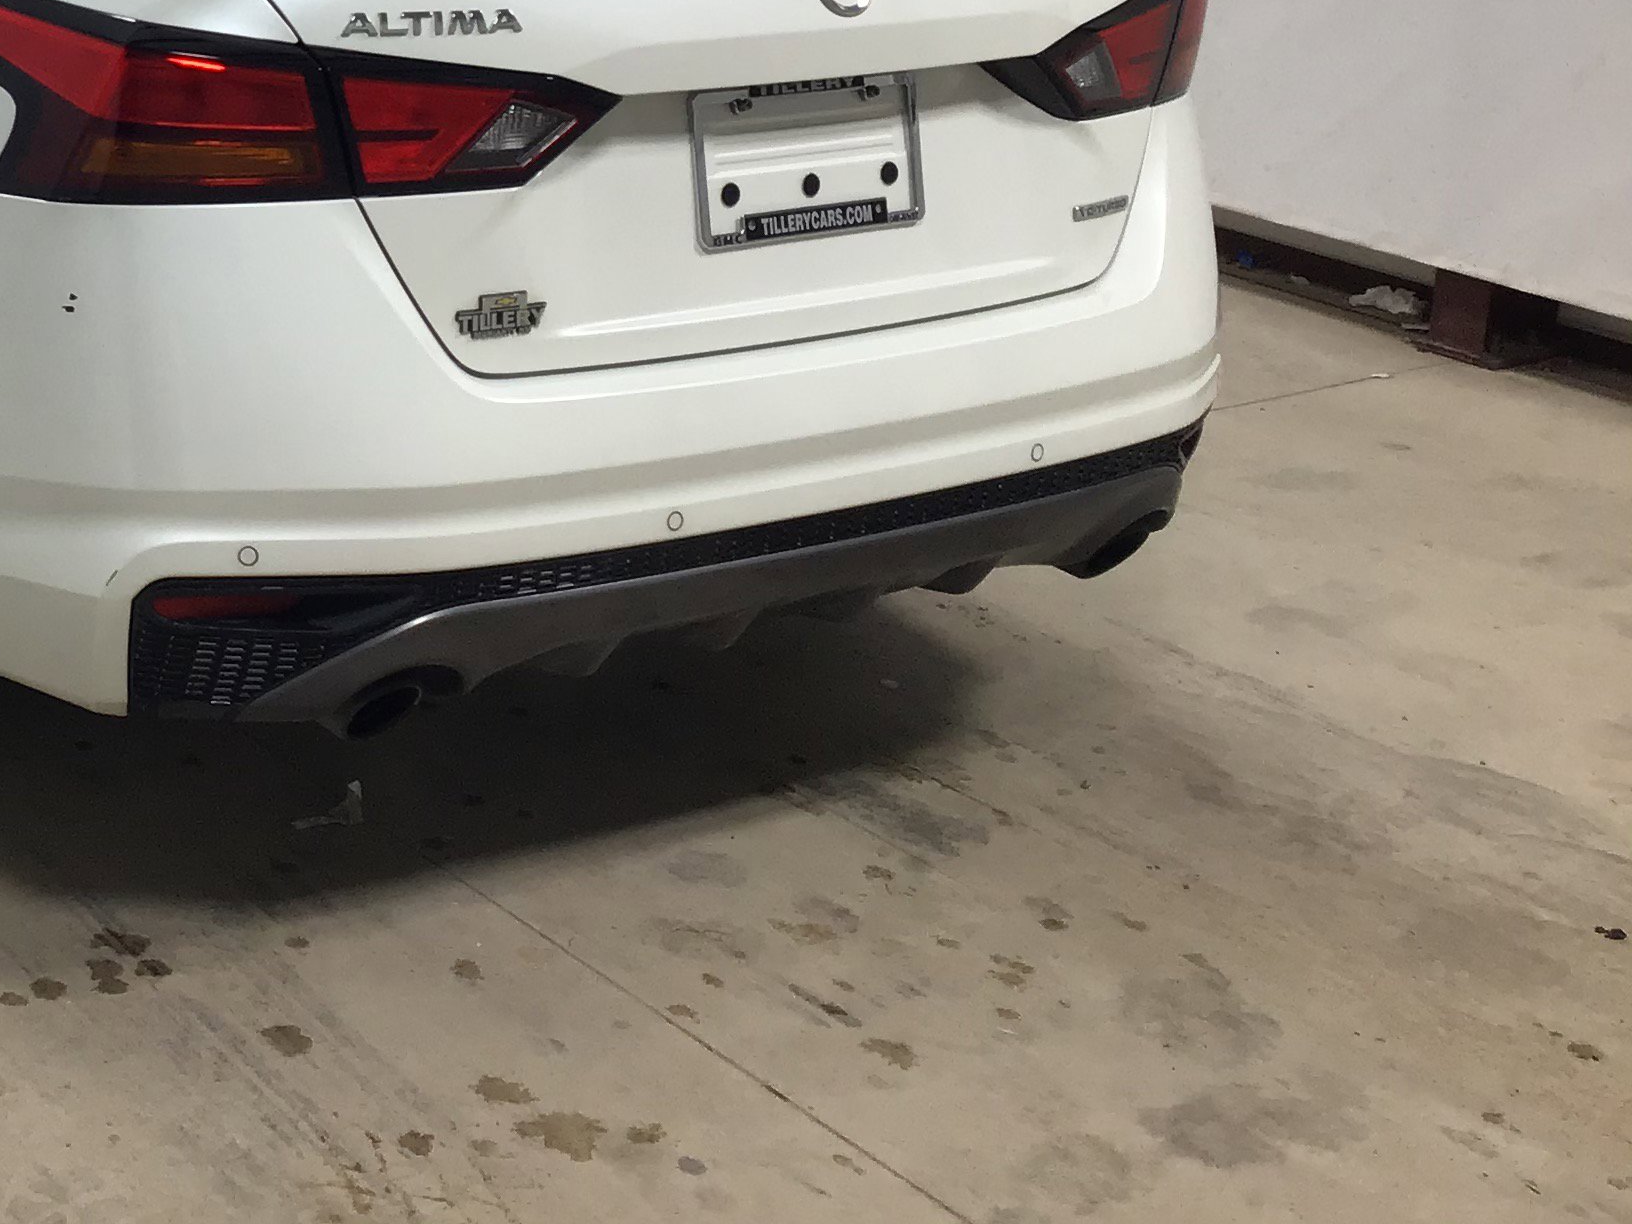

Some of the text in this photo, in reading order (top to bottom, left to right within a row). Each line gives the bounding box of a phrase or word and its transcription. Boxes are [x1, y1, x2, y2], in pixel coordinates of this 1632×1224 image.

[340, 8, 523, 38] ALTIMA
[761, 204, 874, 236] TILLERYCARS.COM
[458, 306, 545, 335] TILLERY
